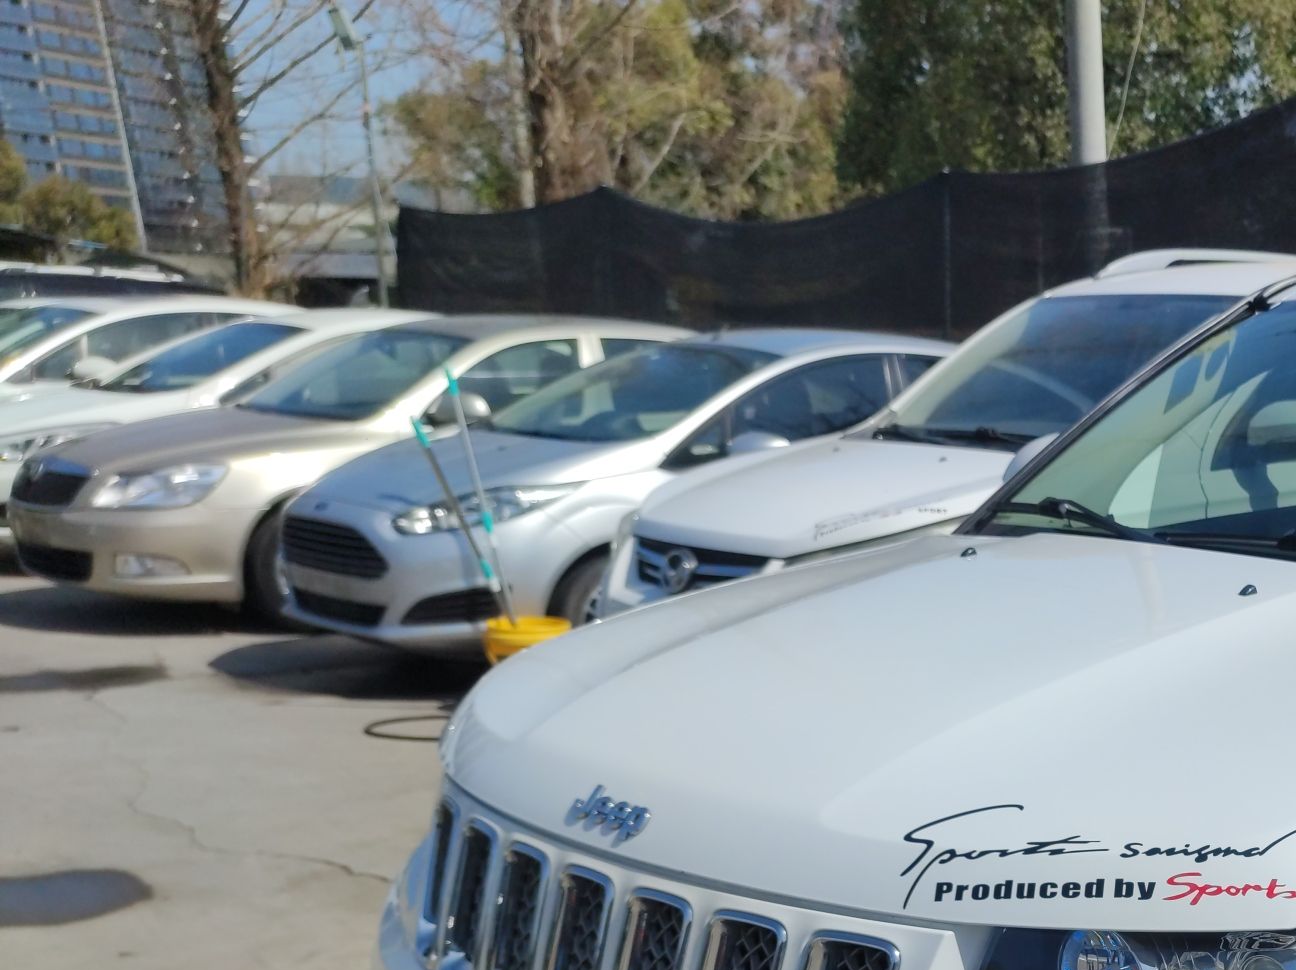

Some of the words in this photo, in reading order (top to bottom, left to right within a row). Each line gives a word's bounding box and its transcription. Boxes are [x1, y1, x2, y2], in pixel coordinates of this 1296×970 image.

[564, 784, 651, 848] Jeep
[934, 878, 1105, 902] Produced
[1113, 878, 1156, 900] by
